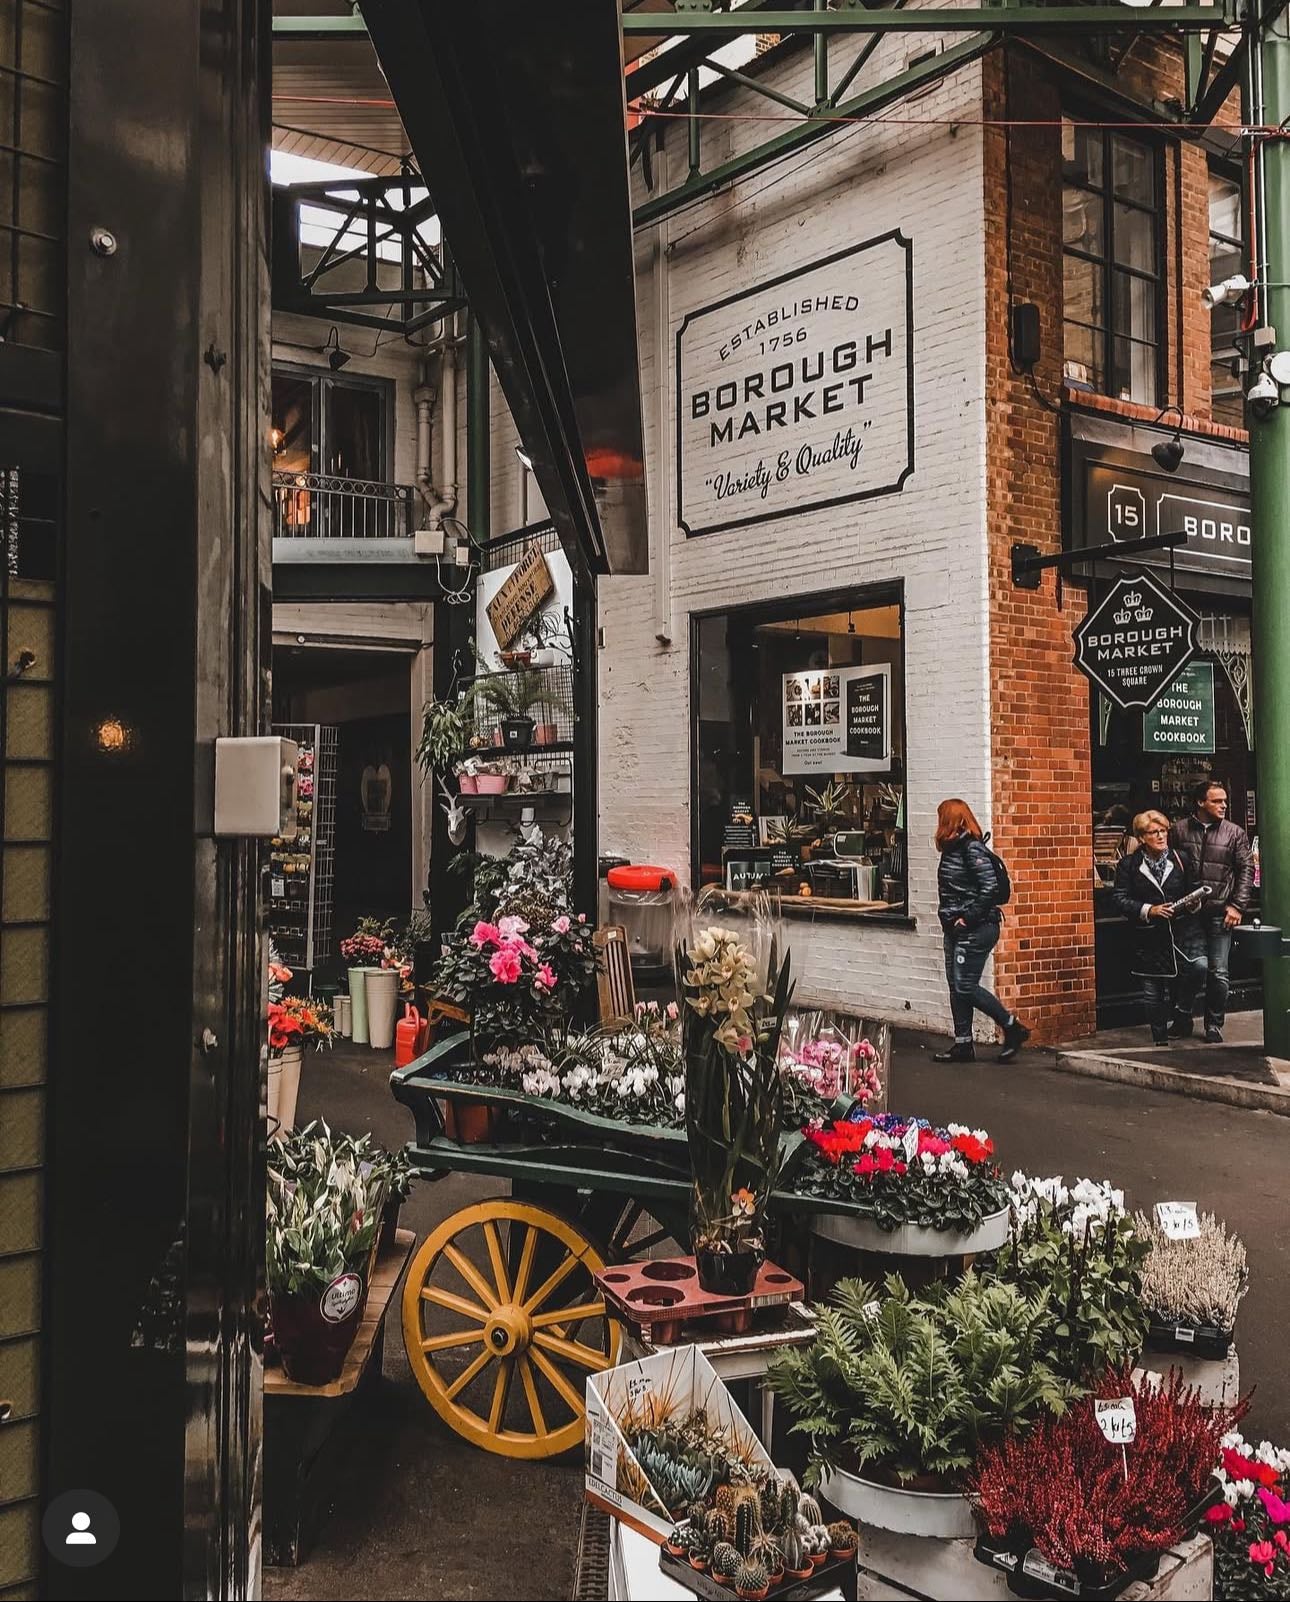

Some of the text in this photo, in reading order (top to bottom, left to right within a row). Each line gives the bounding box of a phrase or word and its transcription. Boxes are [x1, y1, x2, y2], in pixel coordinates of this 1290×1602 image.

[719, 295, 859, 361] ESTABLISHED
[759, 327, 807, 355] 1756
[691, 328, 892, 420] BOROUGH
[710, 373, 873, 447] MARKET
[775, 451, 792, 482] &
[1115, 504, 1139, 526] 15
[1088, 625, 1183, 647] BOROUGH
[1097, 642, 1174, 661] MARKET
[1107, 664, 1163, 678] 15 THREE CROWN
[1122, 676, 1147, 688] SQUARE
[1171, 682, 1189, 693] THE
[859, 694, 870, 702] THE
[851, 704, 879, 714] BOROUGH
[1157, 699, 1202, 711] BOROUGH
[853, 715, 877, 724] MARKET
[1160, 715, 1199, 727] MARKET
[806, 729, 834, 737] BOROUGH
[849, 727, 881, 735] COOKBOOK
[1153, 731, 1206, 744] COOKBOOK
